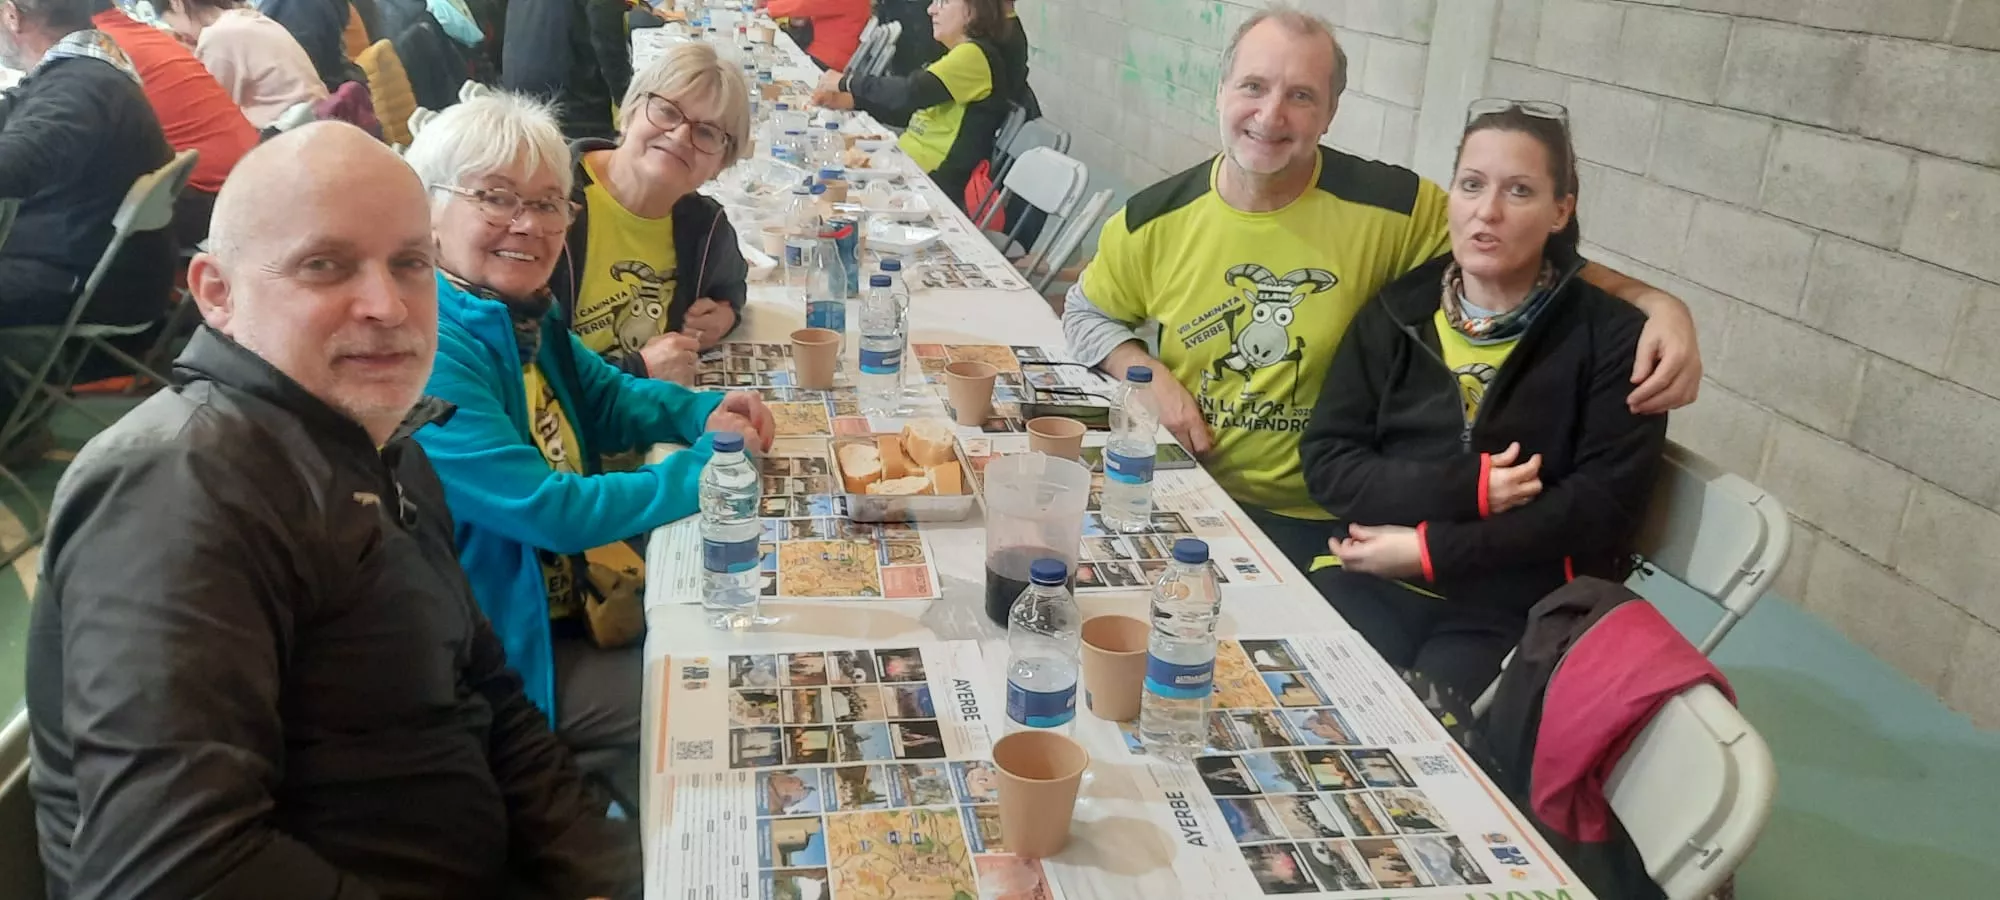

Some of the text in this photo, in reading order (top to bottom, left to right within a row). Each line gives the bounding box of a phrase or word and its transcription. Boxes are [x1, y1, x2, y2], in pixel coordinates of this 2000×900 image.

[574, 315, 614, 337] YERBE
[1191, 296, 1241, 327] CAMINATA
[1184, 322, 1226, 350] AYERBE
[1241, 400, 1285, 418] FLOR
[952, 678, 981, 722] AYERBE
[1165, 791, 1208, 847] AYERBE
